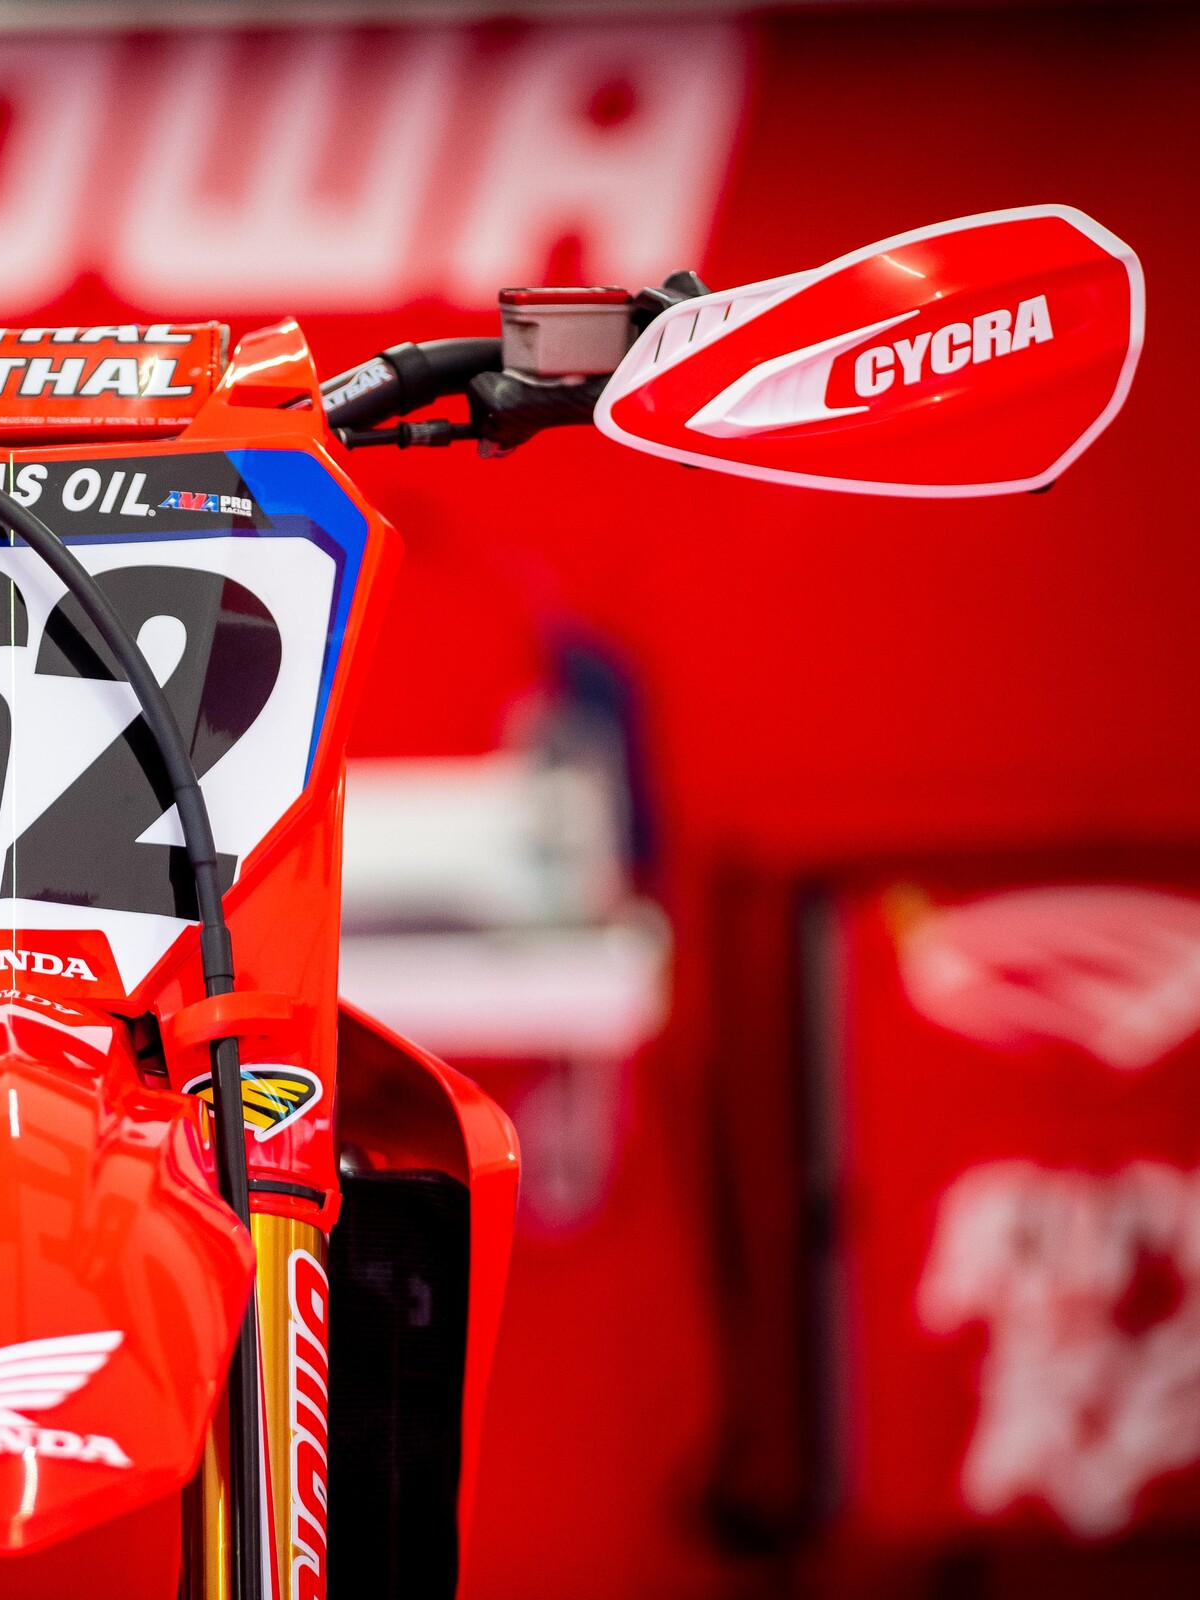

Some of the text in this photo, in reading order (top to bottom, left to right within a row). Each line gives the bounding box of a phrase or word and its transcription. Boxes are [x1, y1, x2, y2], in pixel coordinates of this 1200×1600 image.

[854, 294, 1054, 398] CYCRA
[158, 490, 252, 512] AMA PRO
[220, 506, 252, 517] RACING
